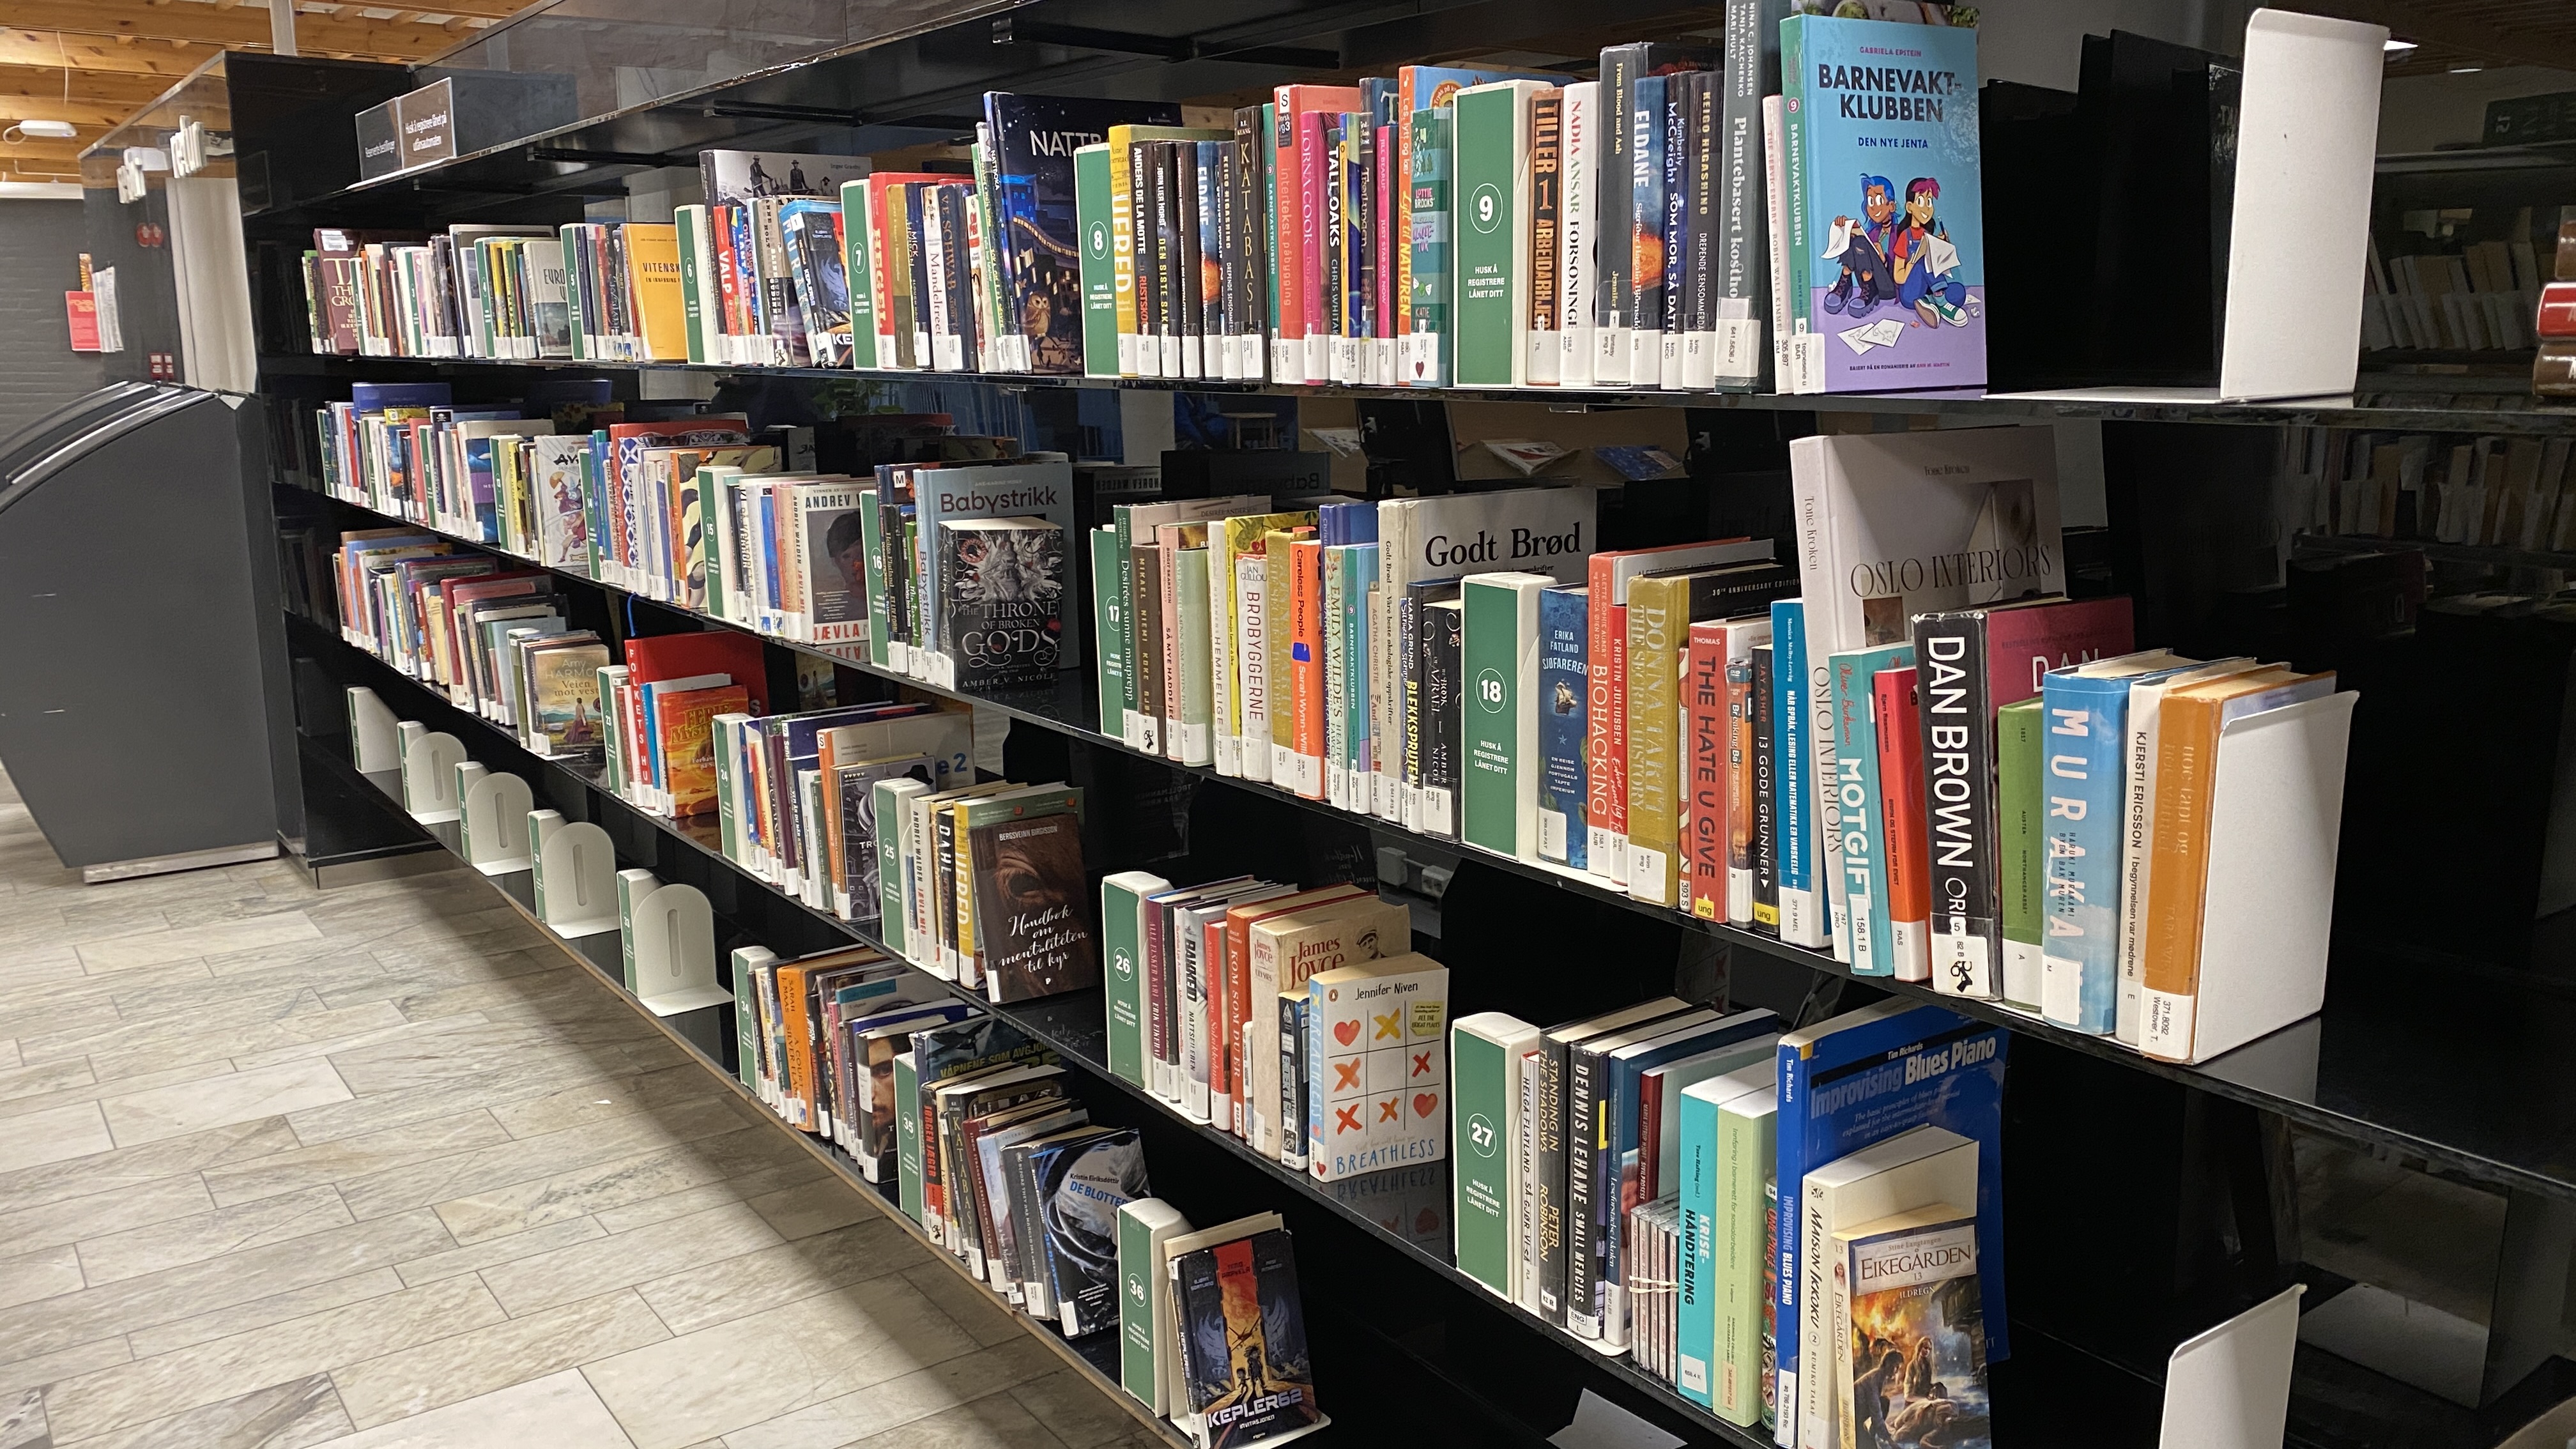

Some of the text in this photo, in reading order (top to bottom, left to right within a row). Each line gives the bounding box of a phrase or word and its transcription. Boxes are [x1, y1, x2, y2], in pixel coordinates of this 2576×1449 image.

[1749, 31, 1754, 40] C.
[1859, 47, 1921, 57] GABRIELA EPSTEIN
[1615, 63, 1623, 88] From
[1818, 64, 1961, 95] BARNEVAKT-
[1840, 97, 1943, 122] KLUBBEN
[1535, 103, 1559, 210] TILLER 1
[1570, 101, 1583, 213] NADIA ANSAR
[1633, 111, 1650, 188] ELDANE
[1667, 103, 1676, 184] McCreight
[1676, 118, 1685, 165] Kimberly
[1858, 137, 1928, 149] DEN NYE JENTA
[1133, 148, 1146, 254] ANDERS DE LA MOTTE
[1303, 128, 1312, 245] LORNA COOK
[1328, 146, 1339, 247] TALL OAKS
[1790, 124, 1802, 246] BARNEVAKTKLUBBEN
[1478, 195, 1493, 221] 9
[1729, 117, 1747, 298] Plantebasert kostho
[1094, 231, 1103, 250] 8
[1400, 193, 1411, 316] Lytt til NATUREN
[643, 262, 681, 273] VITENSK
[718, 250, 732, 293] VALP
[1667, 193, 1679, 335] SOM MOR, SÅ DATTE
[930, 251, 942, 336] Mandeltreet
[1468, 278, 1505, 286] REGISTRERE
[1468, 289, 1503, 298] LÅNET DITT
[940, 487, 1057, 513] Babystrikk
[707, 523, 714, 535] 15
[1425, 521, 1581, 567] Godt Brød
[872, 555, 882, 569] 16
[1850, 545, 2051, 599] OSLO INTERIORS
[919, 551, 931, 636] Babystrikk
[1121, 560, 1130, 606] Desirées
[962, 601, 1057, 617] THE THRONE
[981, 619, 1039, 629] OF BROKEN
[813, 624, 860, 641] JÆVLA
[962, 629, 1060, 656] GODS
[1550, 641, 1579, 654] FATLAND
[1554, 631, 1574, 641] ERIKA
[1246, 592, 1263, 721] BROBYGGERNE
[1331, 586, 1342, 717] EMILY WILDE'S
[1542, 657, 1588, 676] SJØFAREREN
[562, 680, 590, 689] Veien
[1123, 647, 1133, 700] matprepp
[1481, 679, 1499, 701] 18
[576, 687, 598, 696] vest
[1592, 665, 1607, 815] BIOHACKING
[1928, 637, 1974, 868] DAN BROWN
[1698, 657, 1716, 878] THE HATE U GIVE
[1758, 736, 1769, 875] 13 GODE GRUNNER
[2131, 731, 2147, 848] KJERSTI ERICSSON
[884, 845, 894, 860] 25
[939, 825, 951, 873] DAHL
[1008, 905, 1073, 936] Handbok
[1698, 904, 1712, 916] ung
[999, 931, 1087, 966] mentaliteten
[1032, 927, 1054, 939] om
[1298, 937, 1340, 963] James
[1023, 953, 1069, 974] til kyr
[1116, 956, 1130, 972] 26
[1290, 953, 1345, 988] Joyce
[1355, 982, 1418, 1000] Jennifer Niven
[2151, 997, 2161, 1033] Westover,
[2162, 1000, 2170, 1036] 371.8092
[1233, 1030, 1239, 1053] DU
[1234, 1057, 1240, 1077] ER
[1811, 1036, 1996, 1119] Improvising Blues Piano
[1539, 1080, 1548, 1153] SHADOWS
[1549, 1059, 1558, 1151] STANDING IN
[1471, 1122, 1492, 1147] 27
[1336, 1138, 1435, 1175] BREATHLESS
[1070, 1182, 1083, 1193] DE
[1574, 1064, 1588, 1303] DENNIS LEHANE SMALL MERCIES
[1539, 1183, 1548, 1261] ROBINSON
[1549, 1206, 1558, 1248] PETER
[1699, 1214, 1710, 1263] KRISE-
[1685, 1209, 1695, 1305] HÅNDTERING
[1810, 1208, 1822, 1329] MAISON IKKOKU
[1860, 1248, 1971, 1280] EIKEGÅRDEN
[1130, 1278, 1144, 1300] 36
[1208, 1388, 1303, 1428] KEPLER62
